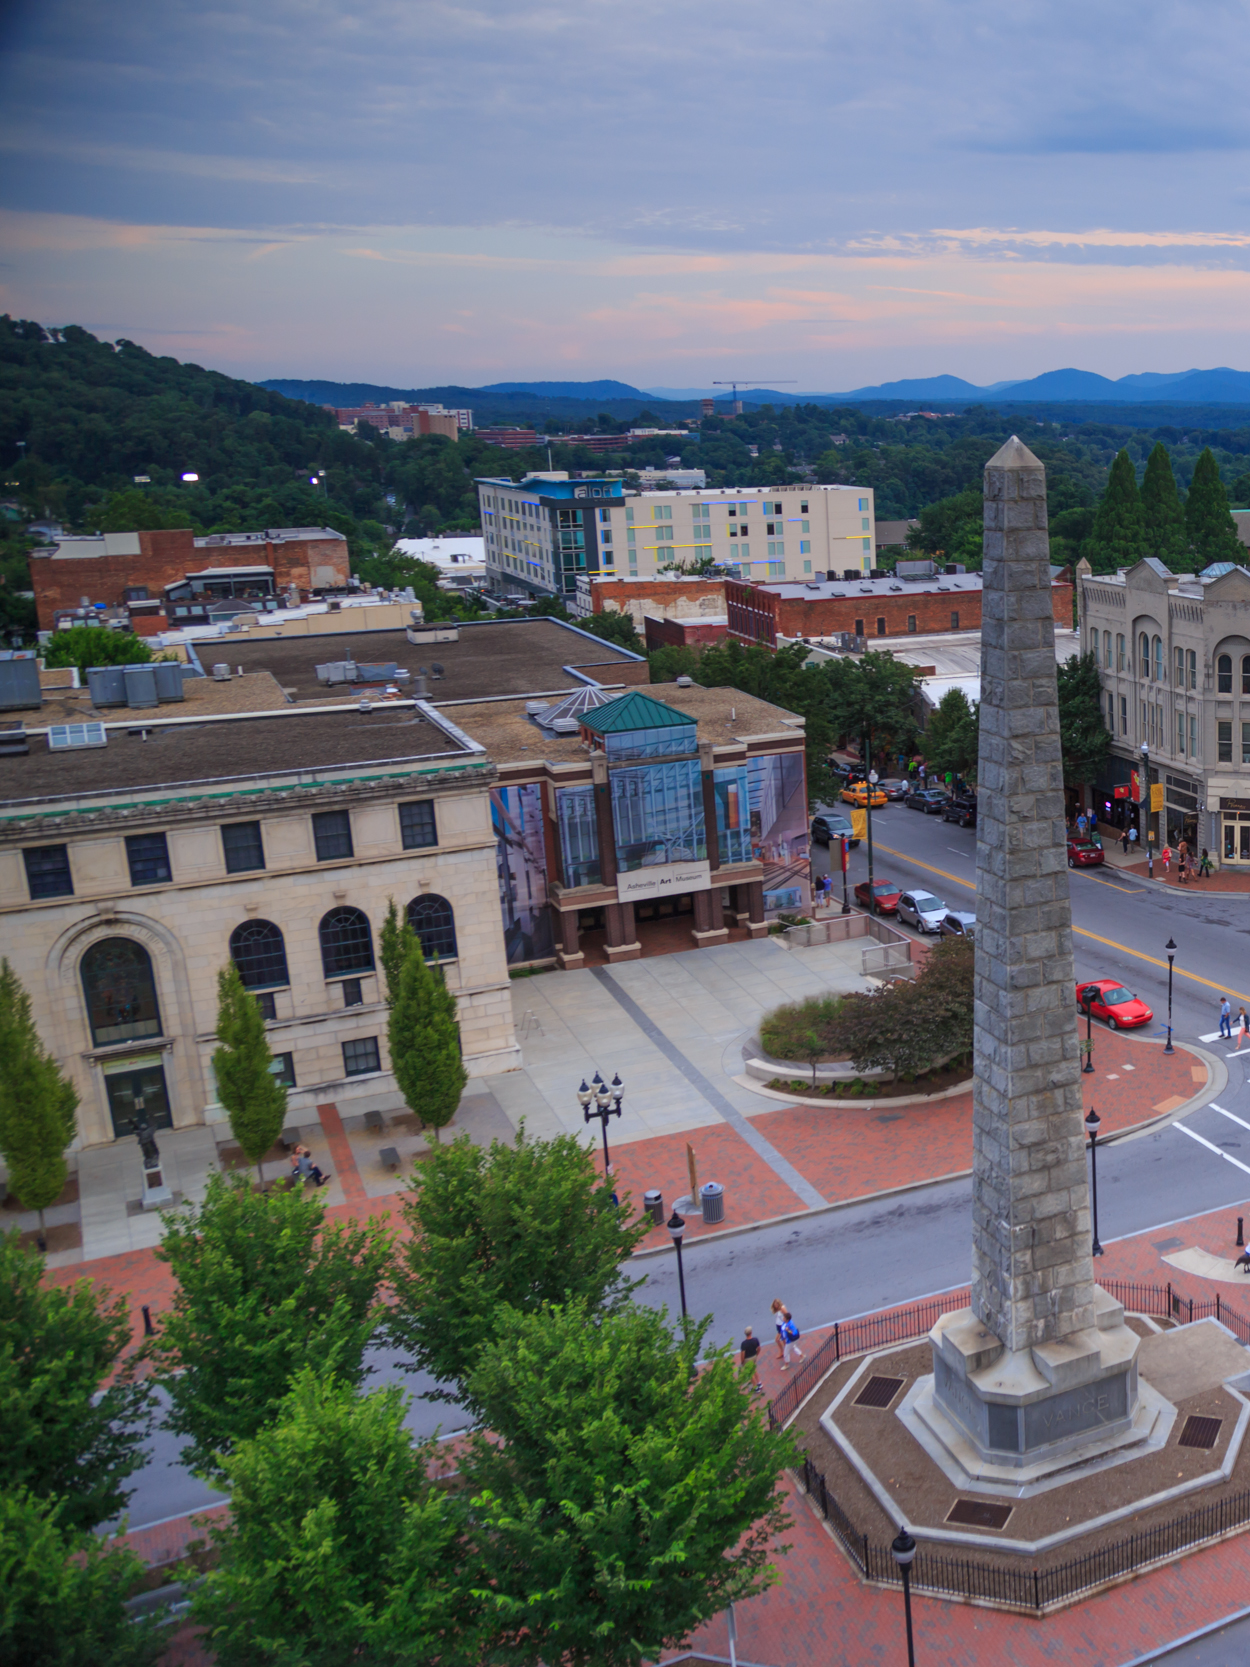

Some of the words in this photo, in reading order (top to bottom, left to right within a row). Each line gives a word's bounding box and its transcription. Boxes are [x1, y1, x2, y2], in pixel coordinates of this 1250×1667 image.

[574, 485, 613, 500] aloft
[627, 880, 656, 890] Asheville
[675, 874, 703, 883] Museum
[1042, 1393, 1109, 1427] VANCE
